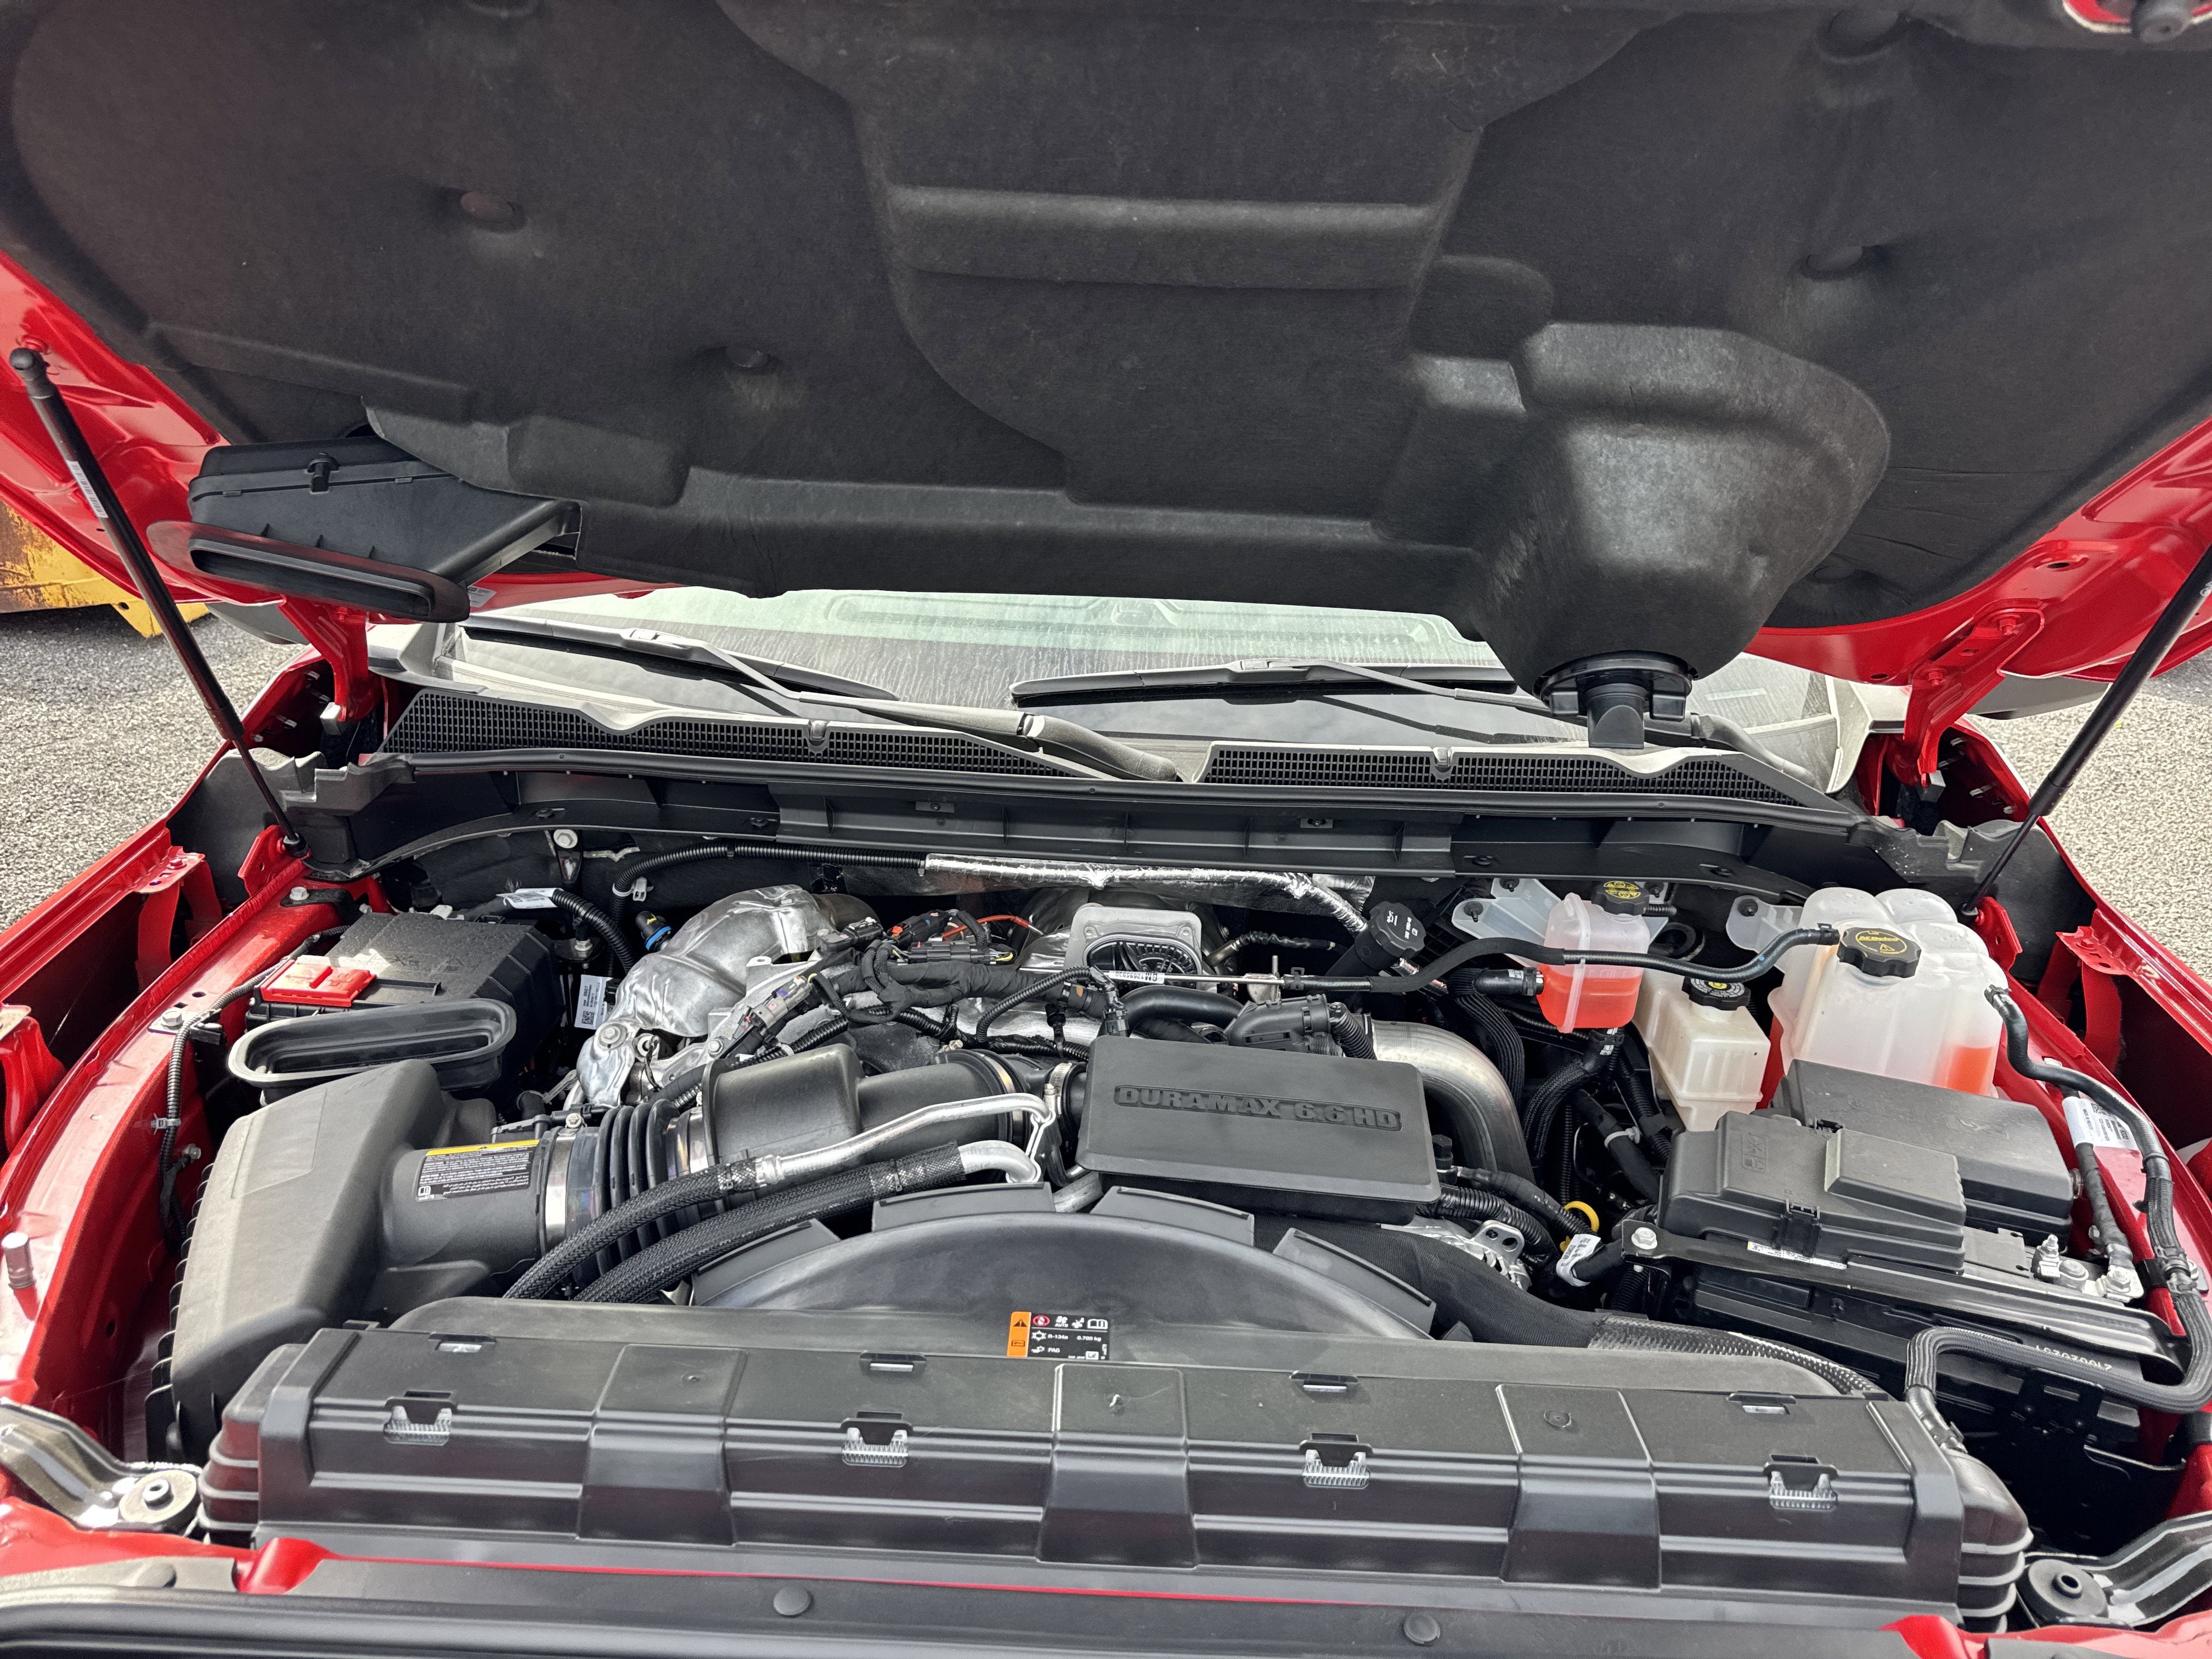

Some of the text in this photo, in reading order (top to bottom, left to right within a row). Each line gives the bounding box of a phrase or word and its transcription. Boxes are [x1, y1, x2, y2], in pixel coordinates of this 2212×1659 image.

[1146, 973, 1158, 981] GM
[1118, 1086, 1399, 1129] DURAMAX 6.6 HD
